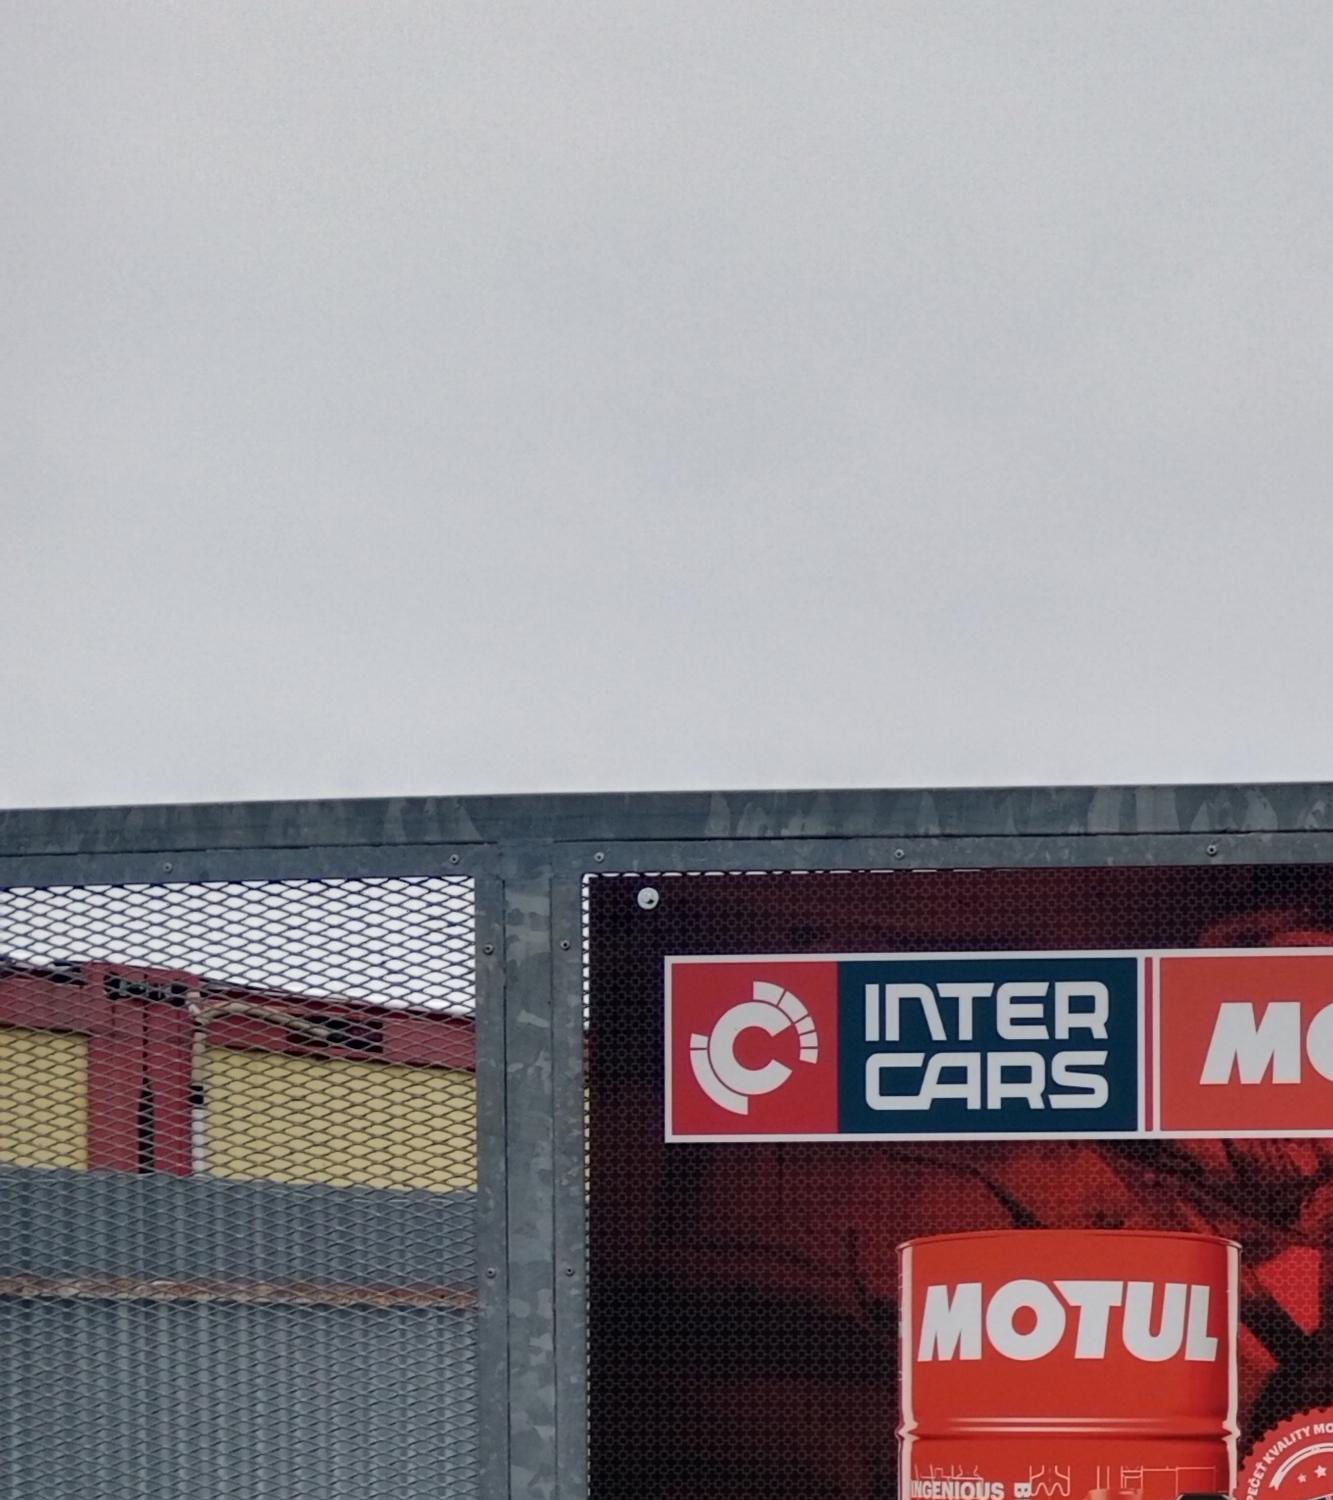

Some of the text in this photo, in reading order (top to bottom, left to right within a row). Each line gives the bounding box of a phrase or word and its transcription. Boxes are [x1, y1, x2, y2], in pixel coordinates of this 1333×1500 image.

[864, 981, 1109, 1041] INTER
[864, 1051, 1109, 1110] CARS
[917, 1280, 1220, 1362] MOTUL
[1263, 1426, 1311, 1465] KVALITY
